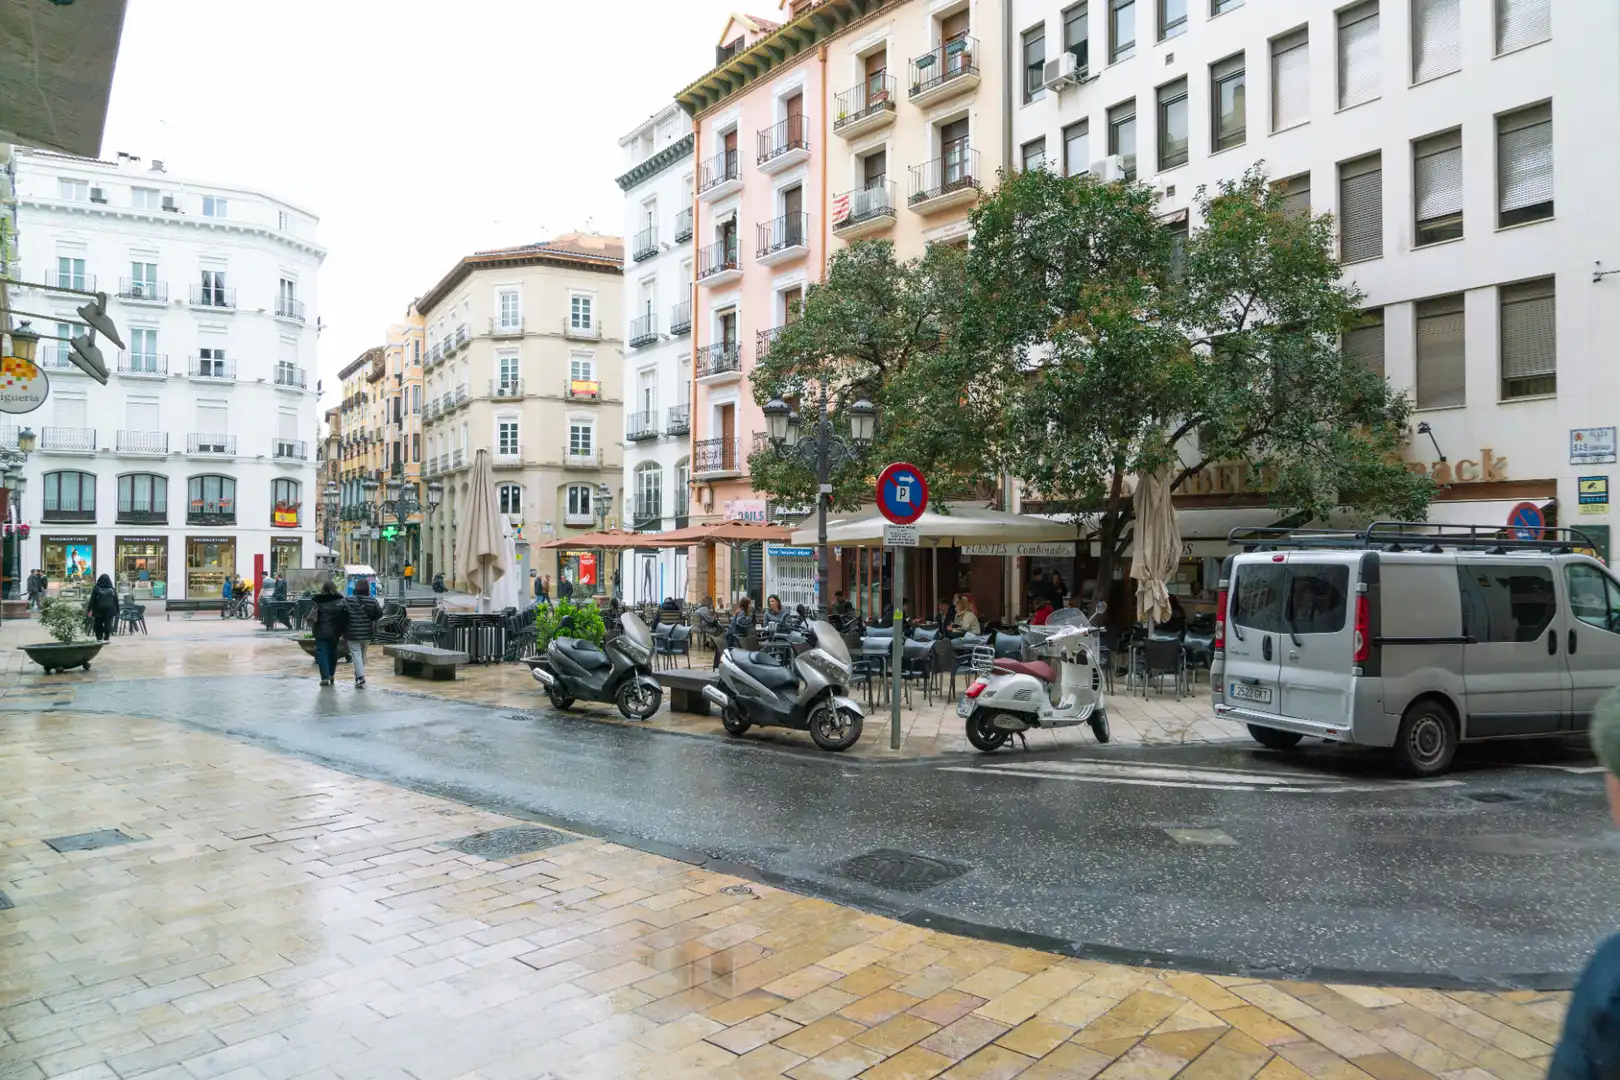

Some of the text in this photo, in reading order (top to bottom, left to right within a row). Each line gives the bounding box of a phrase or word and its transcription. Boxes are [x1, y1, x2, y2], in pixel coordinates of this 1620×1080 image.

[1405, 448, 1509, 484] nack
[899, 487, 907, 500] P
[965, 542, 1069, 555] FUENTES Combinados
[1237, 686, 1268, 700] 2522 GKT
